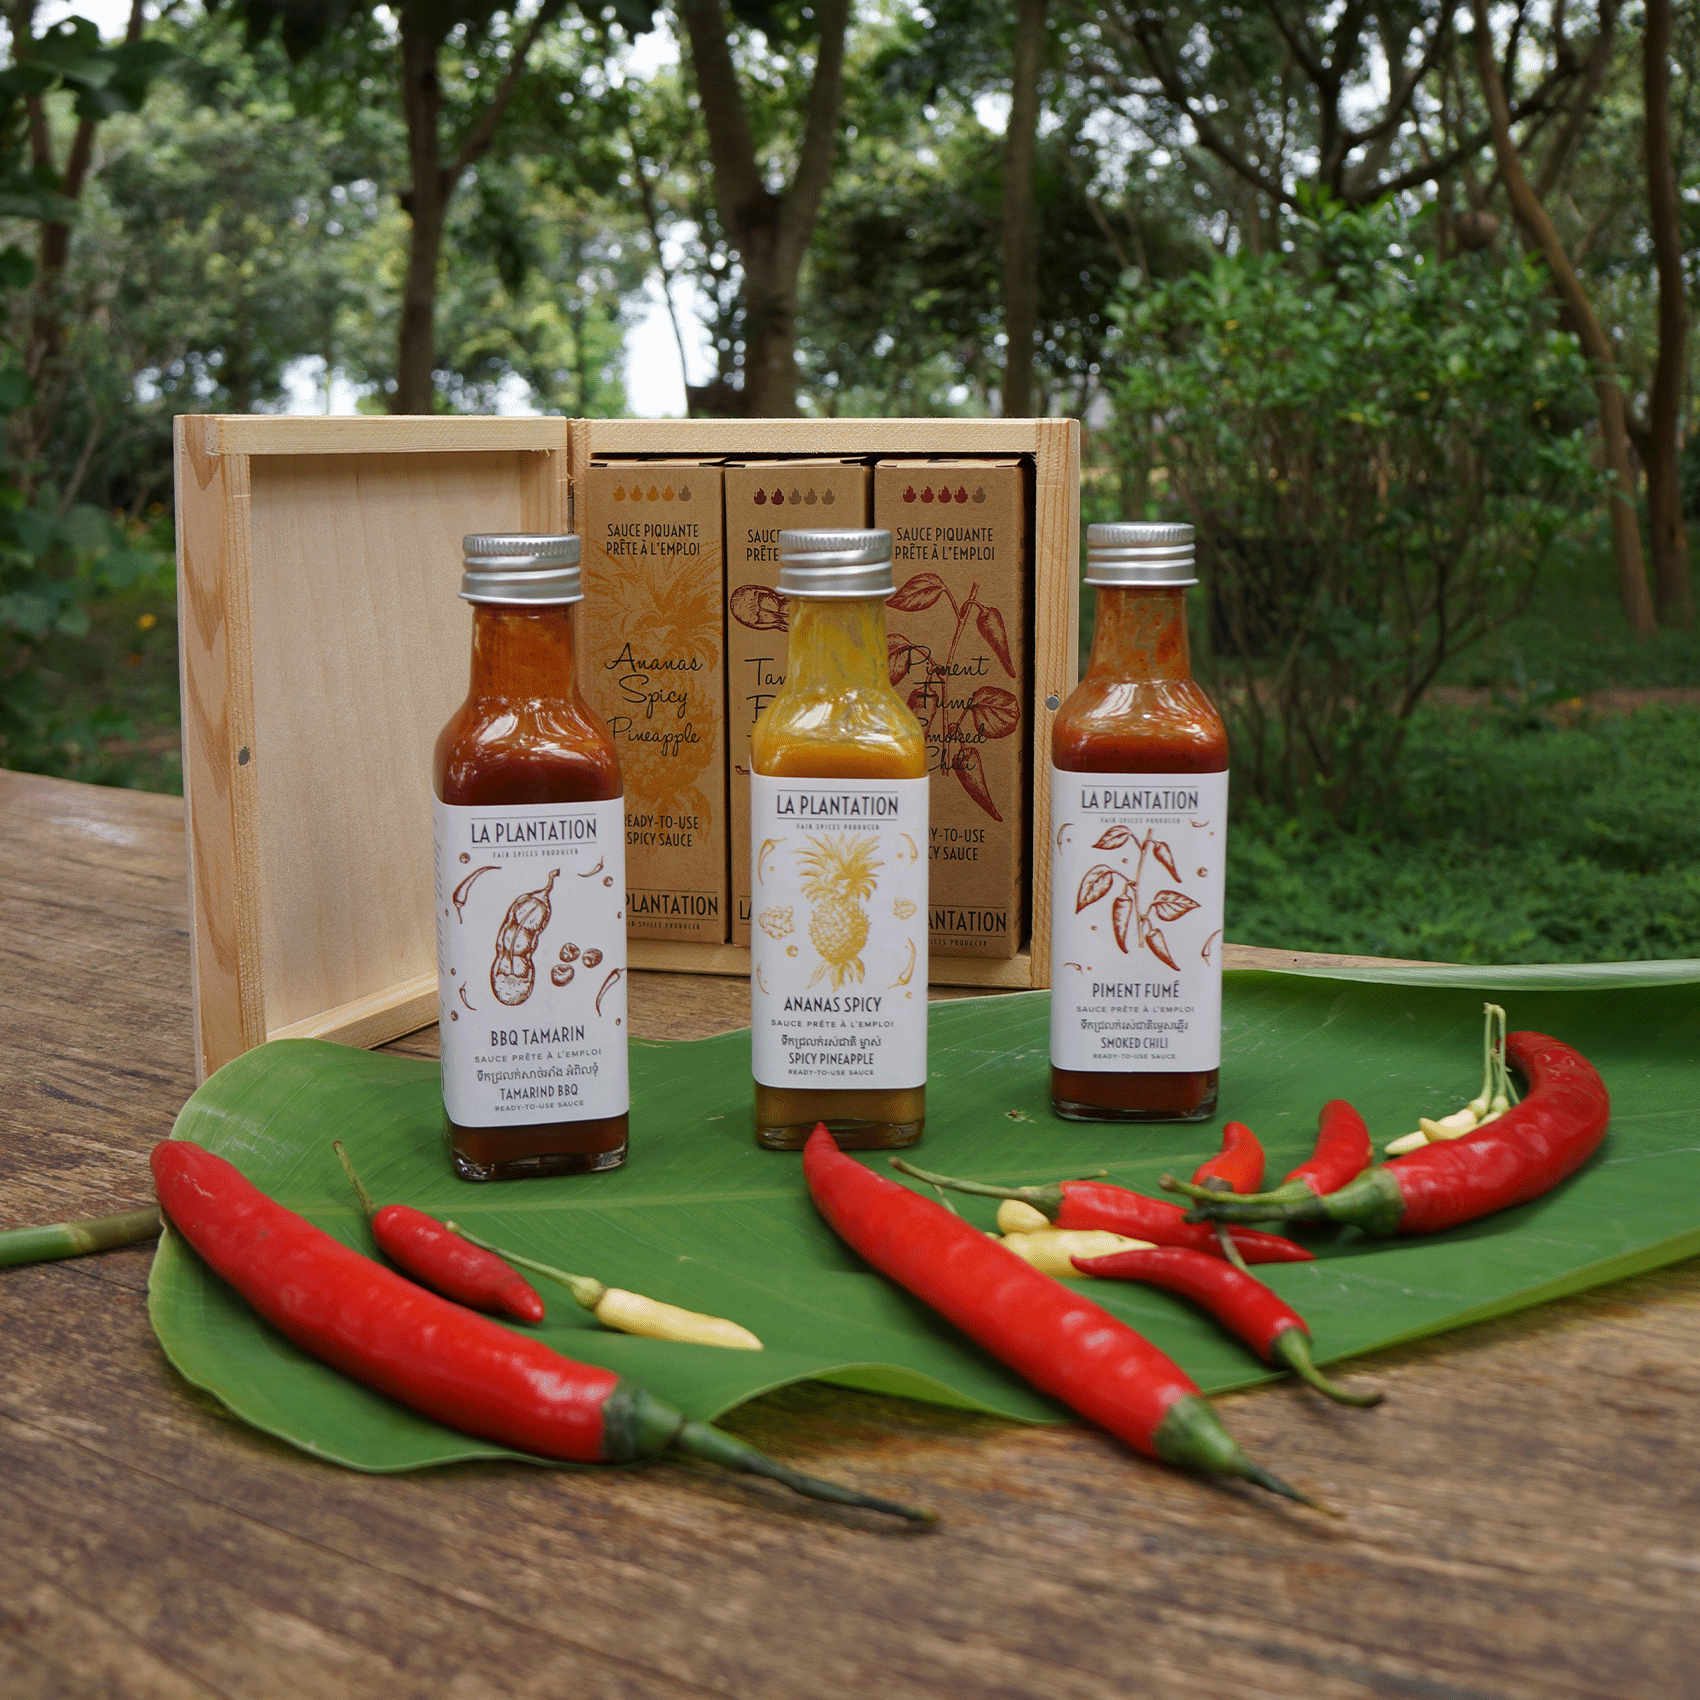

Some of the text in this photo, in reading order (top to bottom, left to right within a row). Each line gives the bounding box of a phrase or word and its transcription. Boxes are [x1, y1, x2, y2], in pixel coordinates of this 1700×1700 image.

[607, 523, 699, 539] SAUCE PIQUANTE
[896, 527, 993, 542] SAUCE PIQUANTE
[606, 538, 700, 556] PRÊTE À L'EMPLOI
[747, 545, 779, 561] PRÊTE
[895, 543, 995, 560] PRÊTE À L'EMPLOI
[604, 642, 703, 673] Ananas
[899, 645, 990, 676] Piment
[618, 674, 688, 719] Spicy
[606, 716, 701, 757] Pineapple
[918, 717, 987, 744] moked
[776, 794, 899, 816] LA PLANTATION
[1081, 790, 1199, 809] LA PLANTATION
[471, 818, 597, 844] LA PLANTATION
[816, 823, 840, 831] SPICES
[627, 831, 693, 847] SPICY SAUCE
[493, 848, 579, 859] FAIR SPICES PRODUCER
[943, 846, 979, 861] SAUCE
[638, 921, 662, 929] SPICES
[665, 922, 701, 930] PRODUCER
[1092, 980, 1180, 998] PIMENT FUMÉ
[784, 996, 882, 1013] ANANAS SPICY
[1076, 1005, 1106, 1013] SAUCE
[1110, 1004, 1139, 1013] PRÊTE
[1142, 1004, 1149, 1013] À
[771, 1018, 894, 1028] SAUCE PRÊTE À L'EMPLOI
[490, 1024, 585, 1047] BBQ TAMARIN
[1100, 1037, 1169, 1049] SMOKED CHILI
[474, 1048, 602, 1064] SAUCE PRÊTE À L'EMPLOI
[789, 1052, 875, 1065] SPICY PINEAPPLE
[500, 1083, 579, 1101] TAMARIND BBQ
[494, 1099, 584, 1112] READY-TO-USE SAUCE
